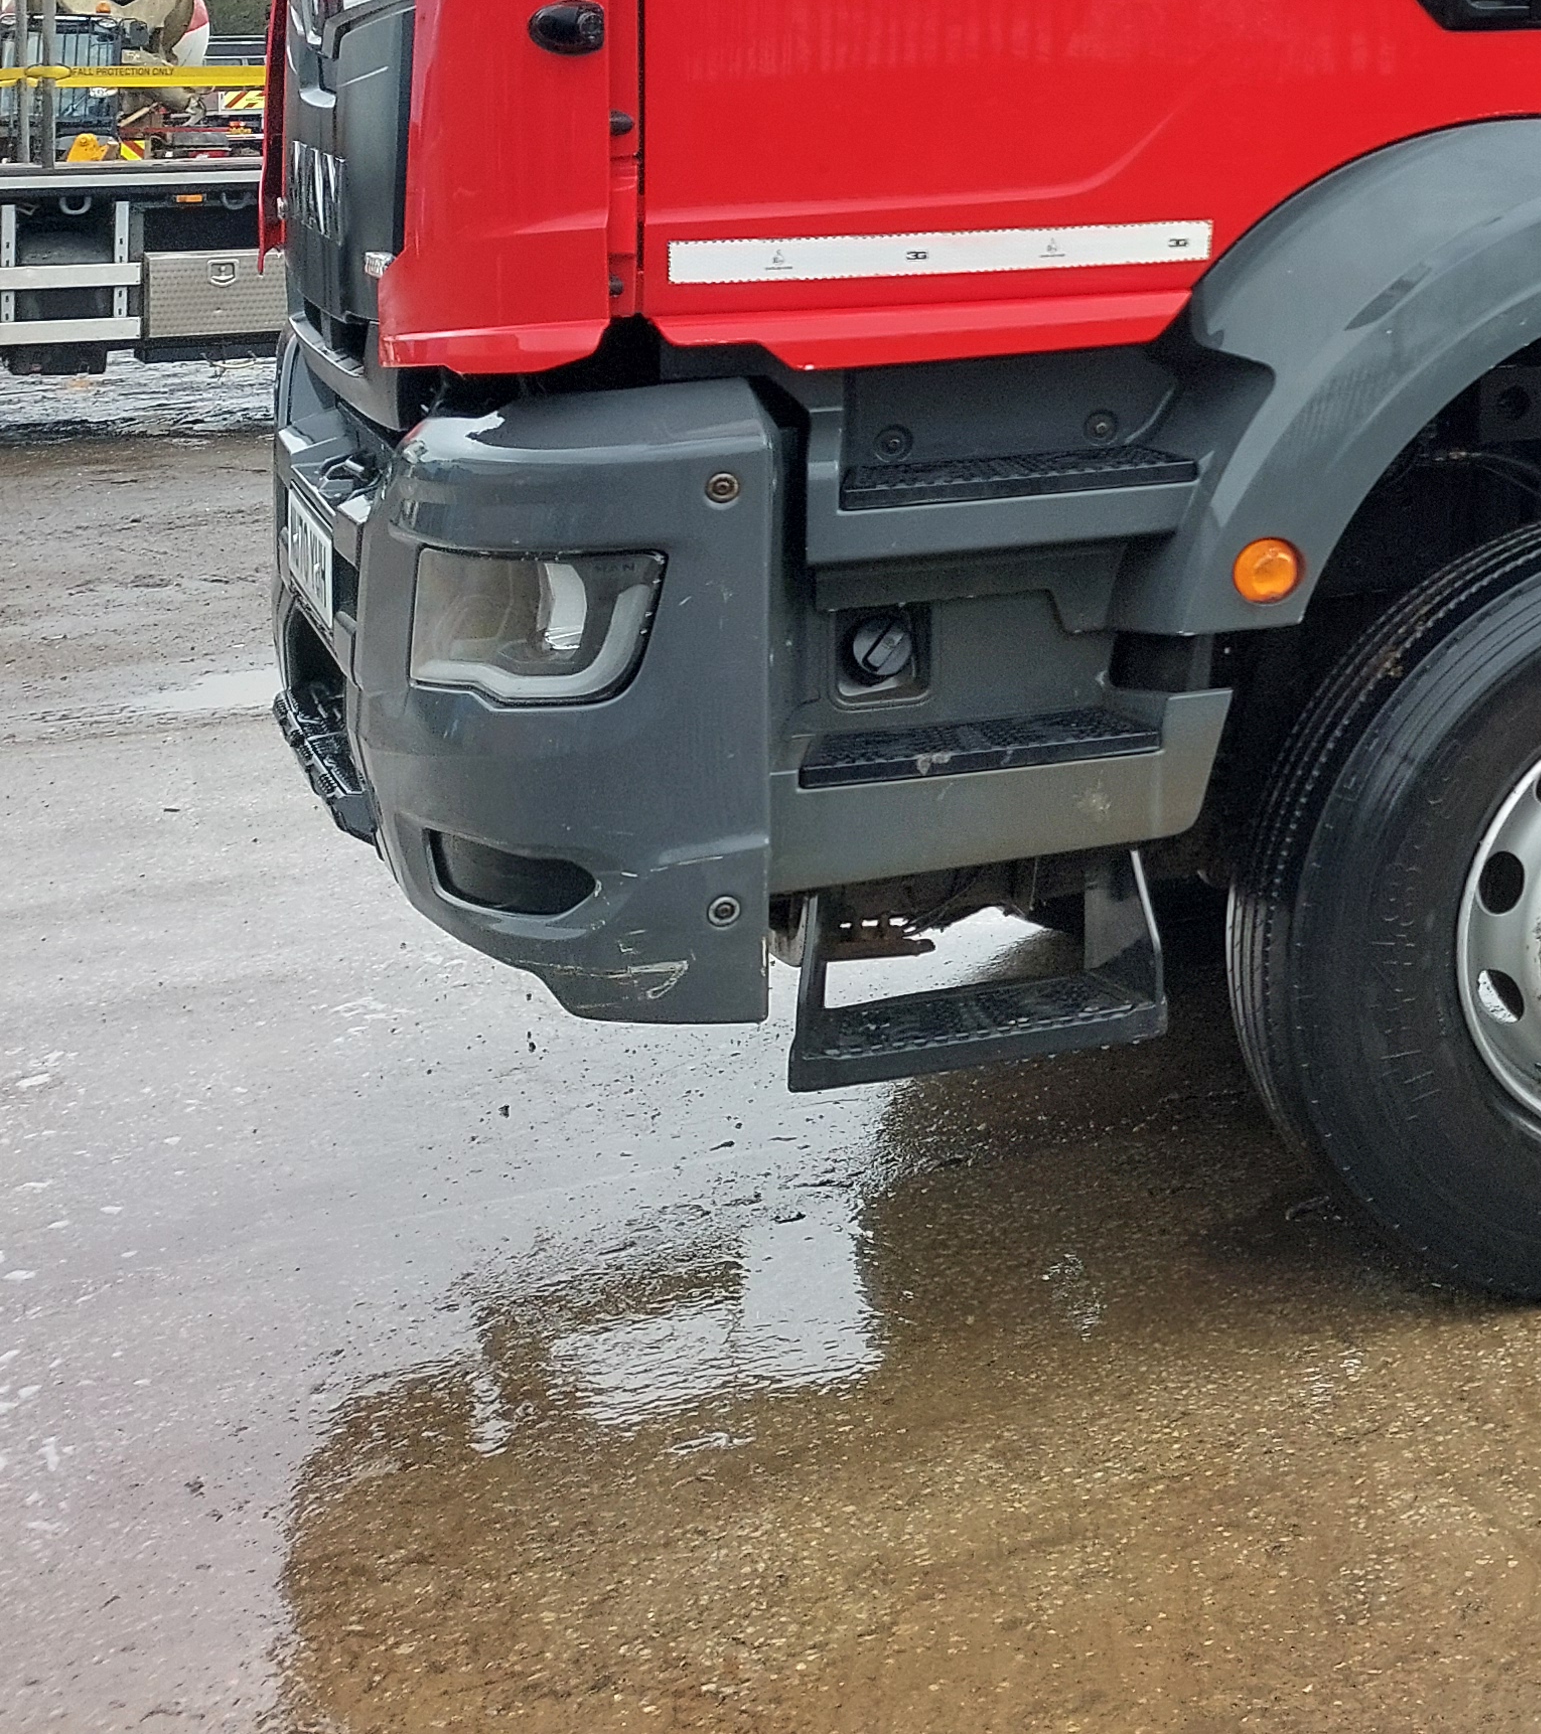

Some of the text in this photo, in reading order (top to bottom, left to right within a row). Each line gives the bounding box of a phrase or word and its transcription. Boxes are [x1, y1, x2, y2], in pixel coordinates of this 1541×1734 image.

[72, 67, 174, 77] FALL PROTECTION ONLY
